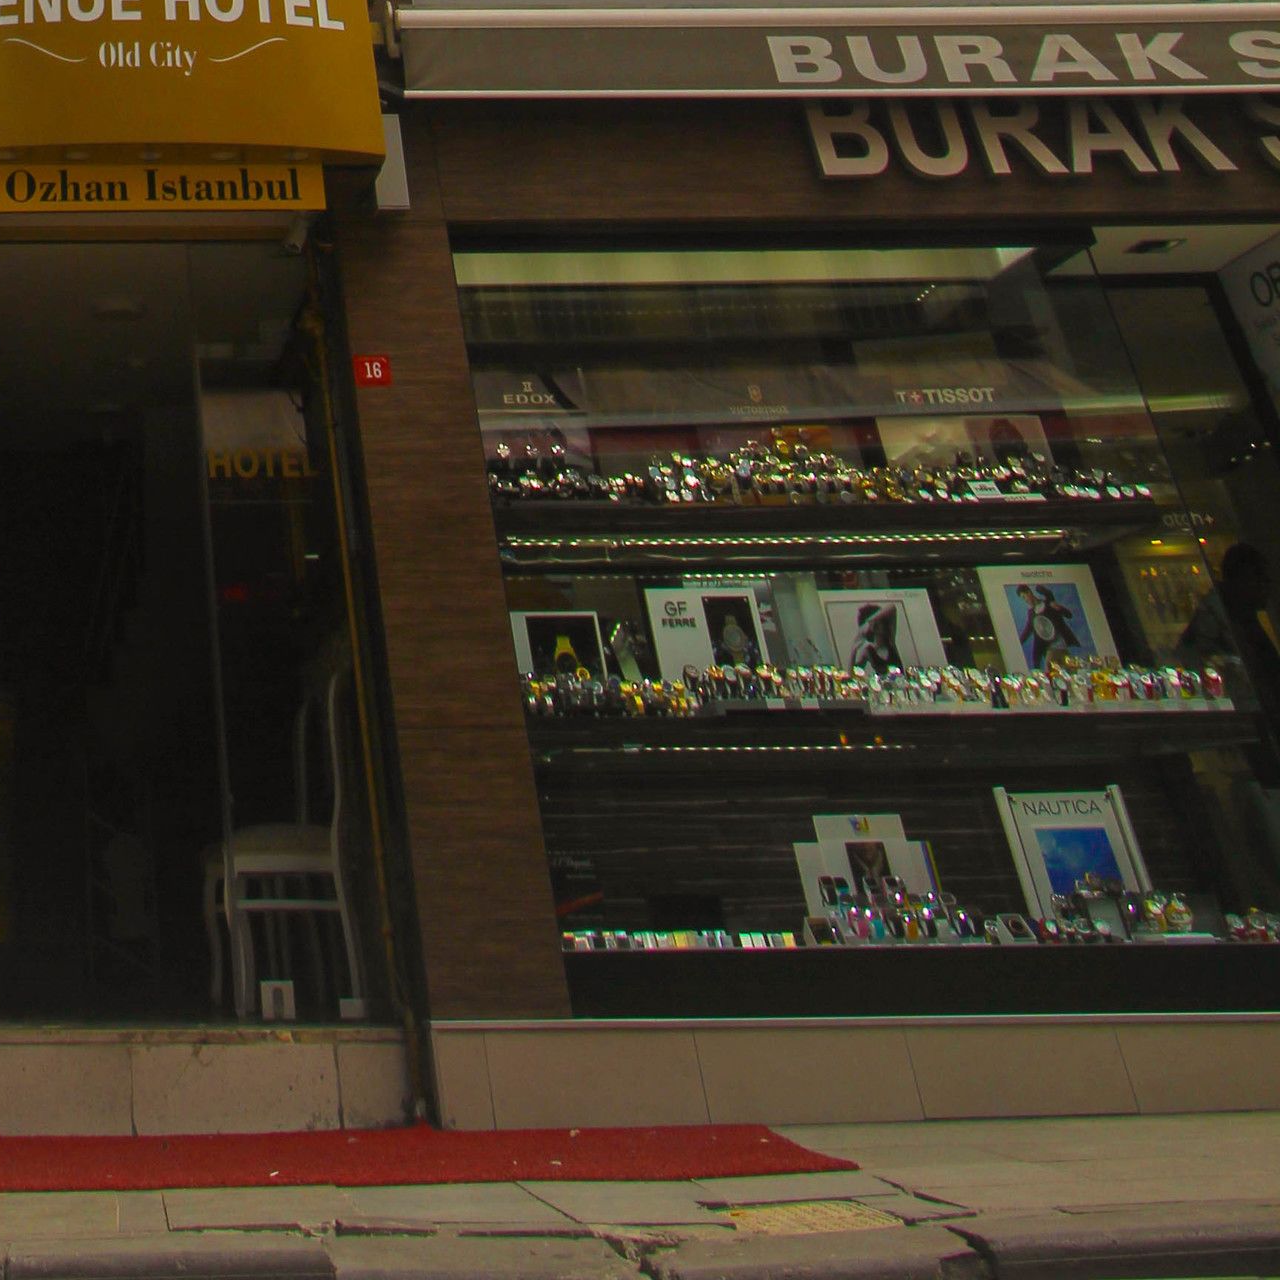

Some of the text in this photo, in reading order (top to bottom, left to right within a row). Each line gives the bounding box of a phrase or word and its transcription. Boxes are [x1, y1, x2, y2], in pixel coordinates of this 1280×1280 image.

[98, 41, 198, 76] Old City
[765, 32, 1209, 83] BURAK
[803, 94, 1240, 178] BURAK
[4, 166, 303, 203] Ozhan Istanbul
[364, 361, 382, 378] 16
[503, 393, 556, 405] EDOX
[922, 387, 995, 404] TISSOT
[207, 447, 320, 480] HOTEL
[664, 601, 687, 617] GF
[661, 617, 697, 628] FERRE
[1021, 799, 1103, 817] NAUTICA
